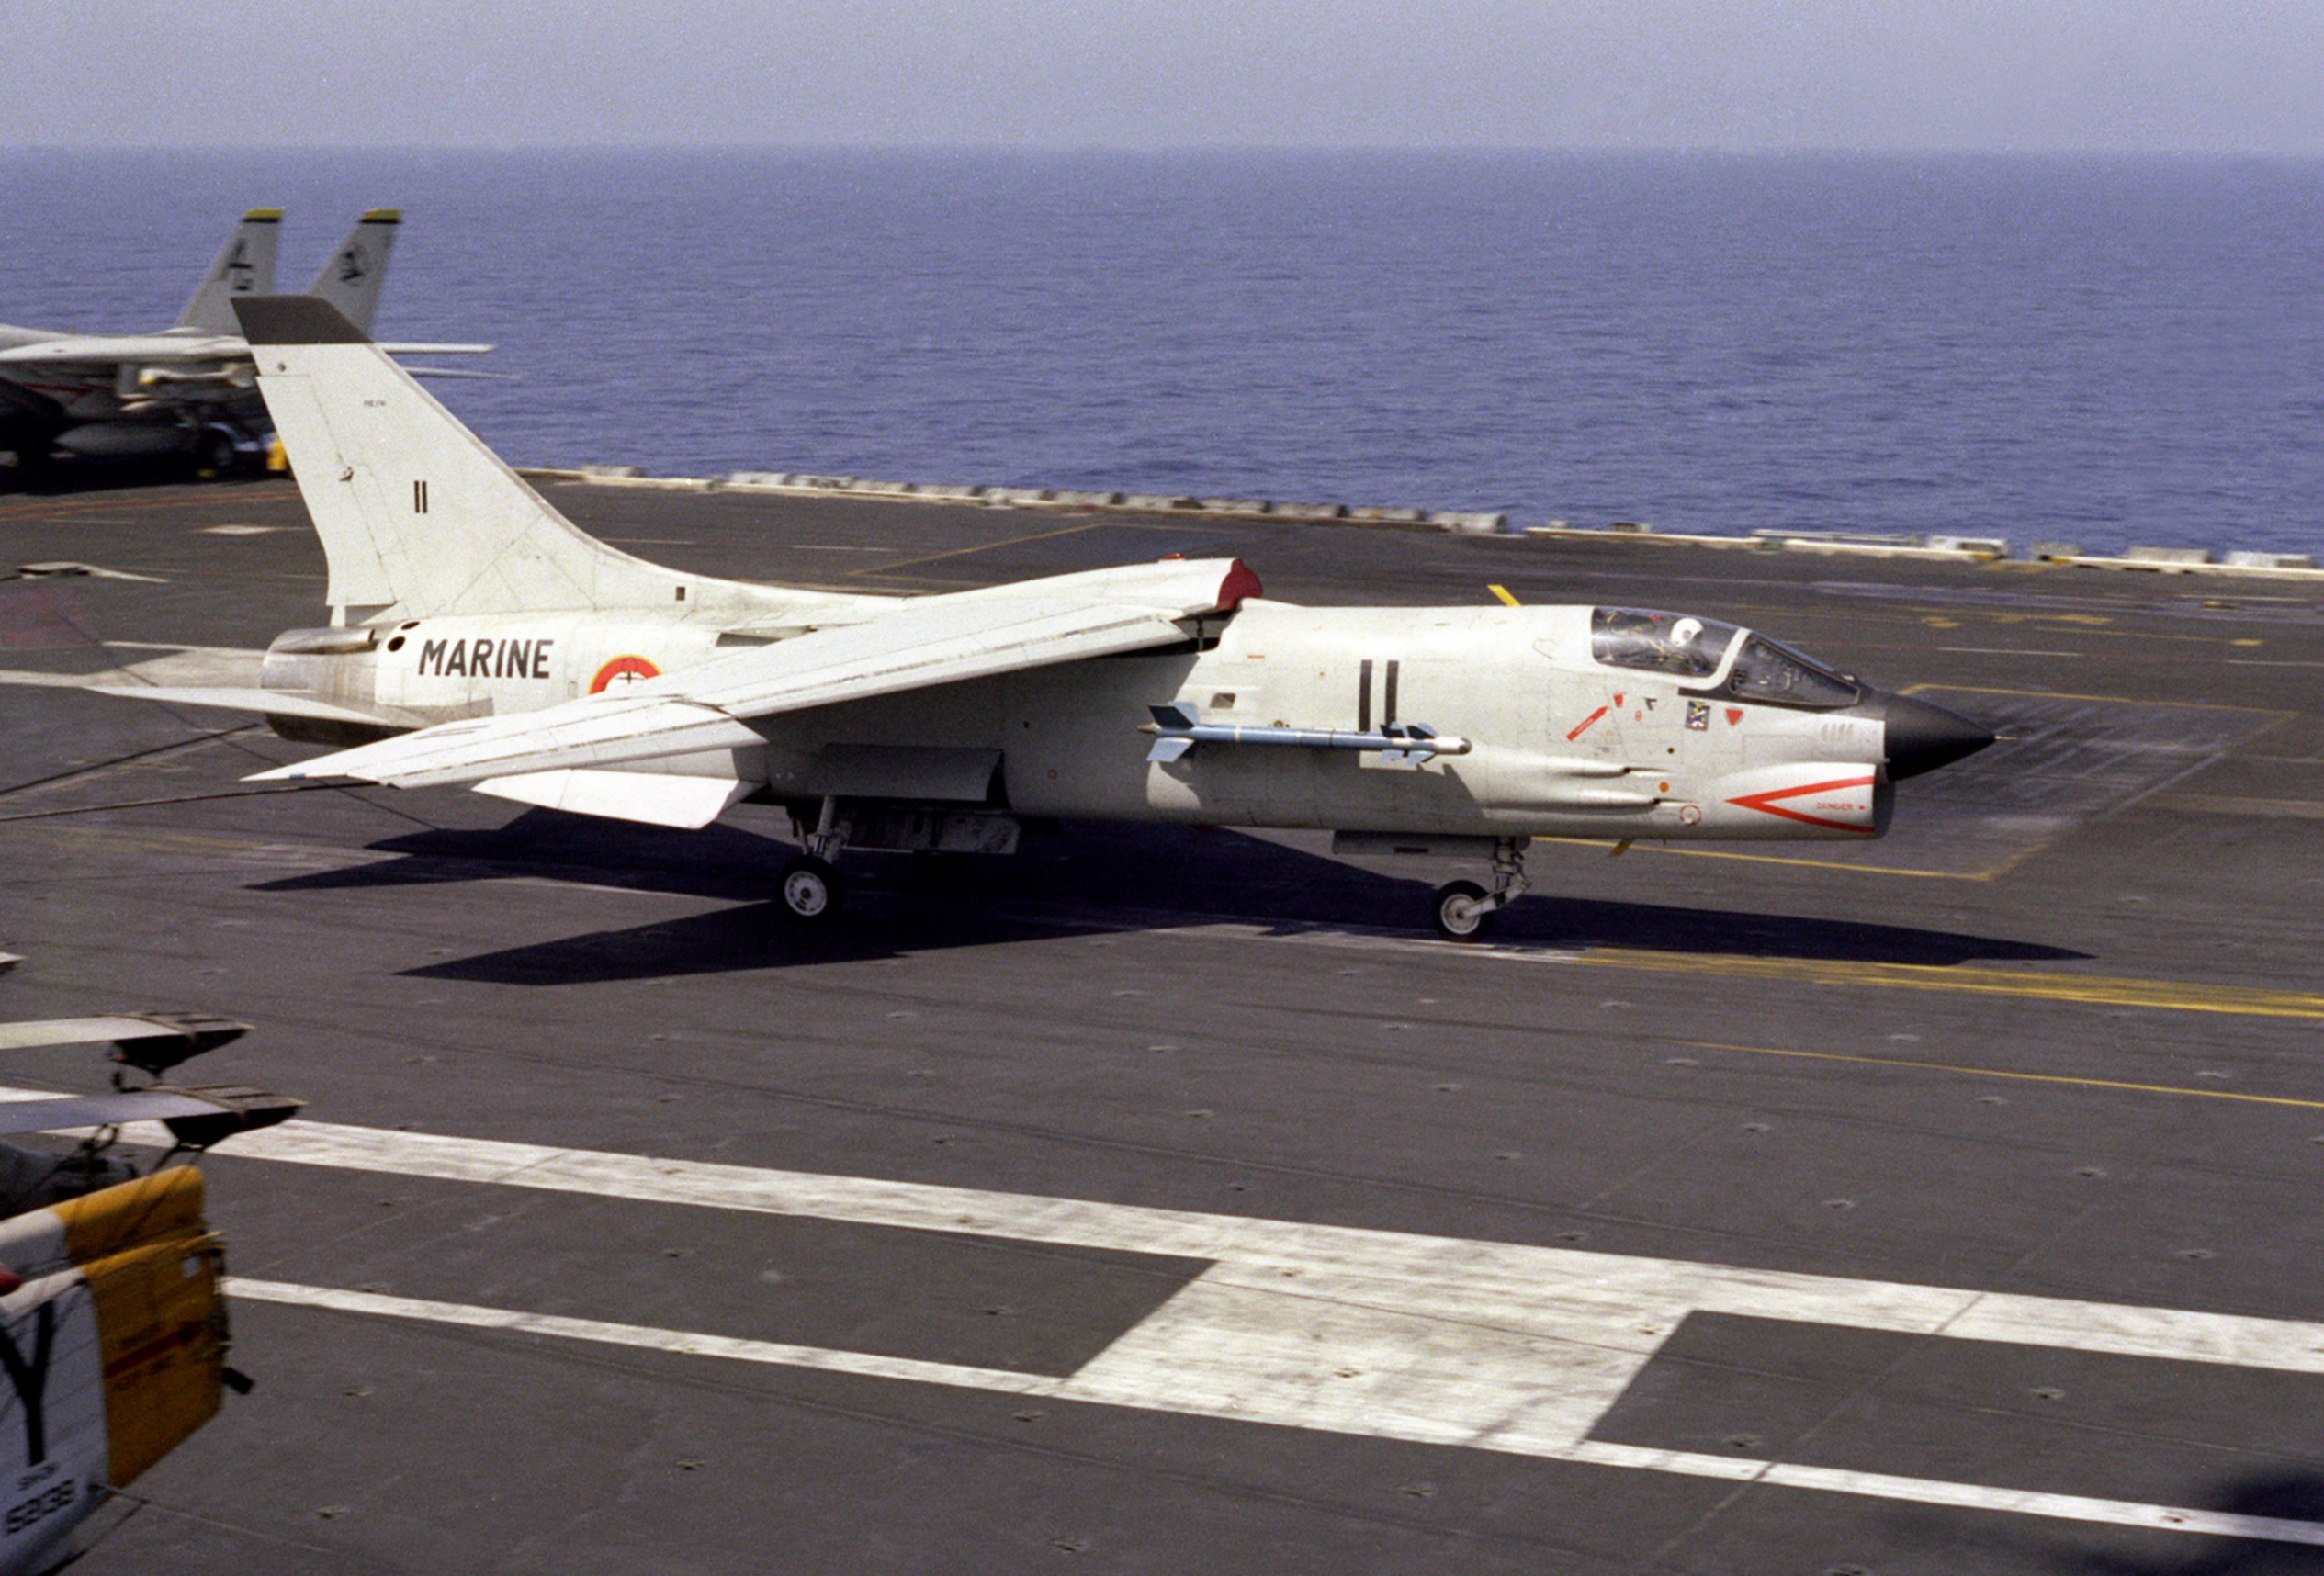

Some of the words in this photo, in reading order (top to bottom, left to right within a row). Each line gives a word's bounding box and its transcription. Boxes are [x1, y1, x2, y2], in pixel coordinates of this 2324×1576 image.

[413, 480, 428, 514] 11
[418, 638, 555, 679] MARINE
[1358, 659, 1400, 733] 11
[1816, 801, 1855, 811] DANGER
